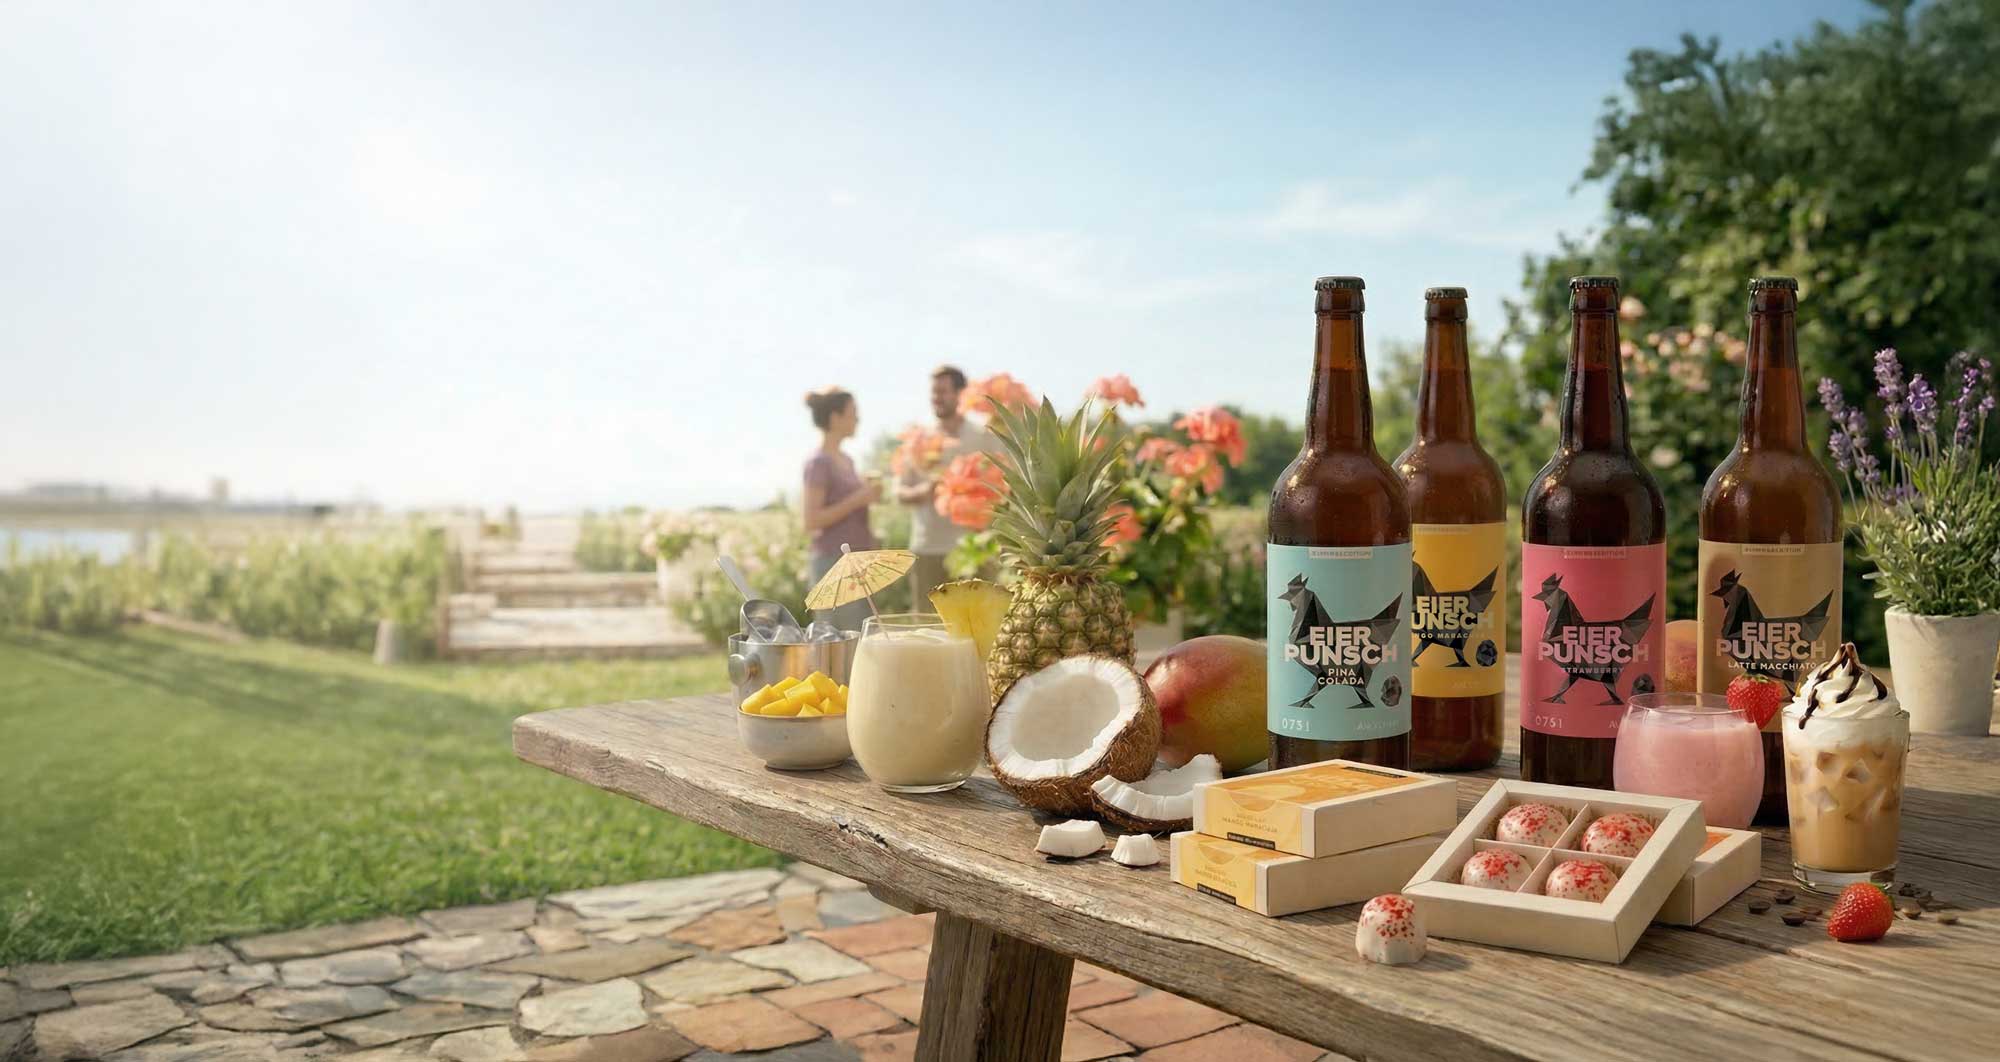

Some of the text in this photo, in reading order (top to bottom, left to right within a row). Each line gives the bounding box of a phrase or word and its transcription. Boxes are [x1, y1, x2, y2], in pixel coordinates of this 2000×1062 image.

[1416, 596, 1469, 613] EIER
[1411, 611, 1494, 630] UNSCH
[1310, 626, 1371, 646] EIER
[1562, 626, 1622, 646] EIER
[1742, 621, 1801, 642] EIER
[1284, 644, 1398, 666] PUNSCH
[1538, 642, 1648, 664] PUNSCH
[1716, 638, 1826, 660] PUNSCH
[1328, 668, 1355, 677] PINA
[1728, 661, 1817, 671] LATTE MACCHIATO
[1318, 676, 1365, 685] COLADA
